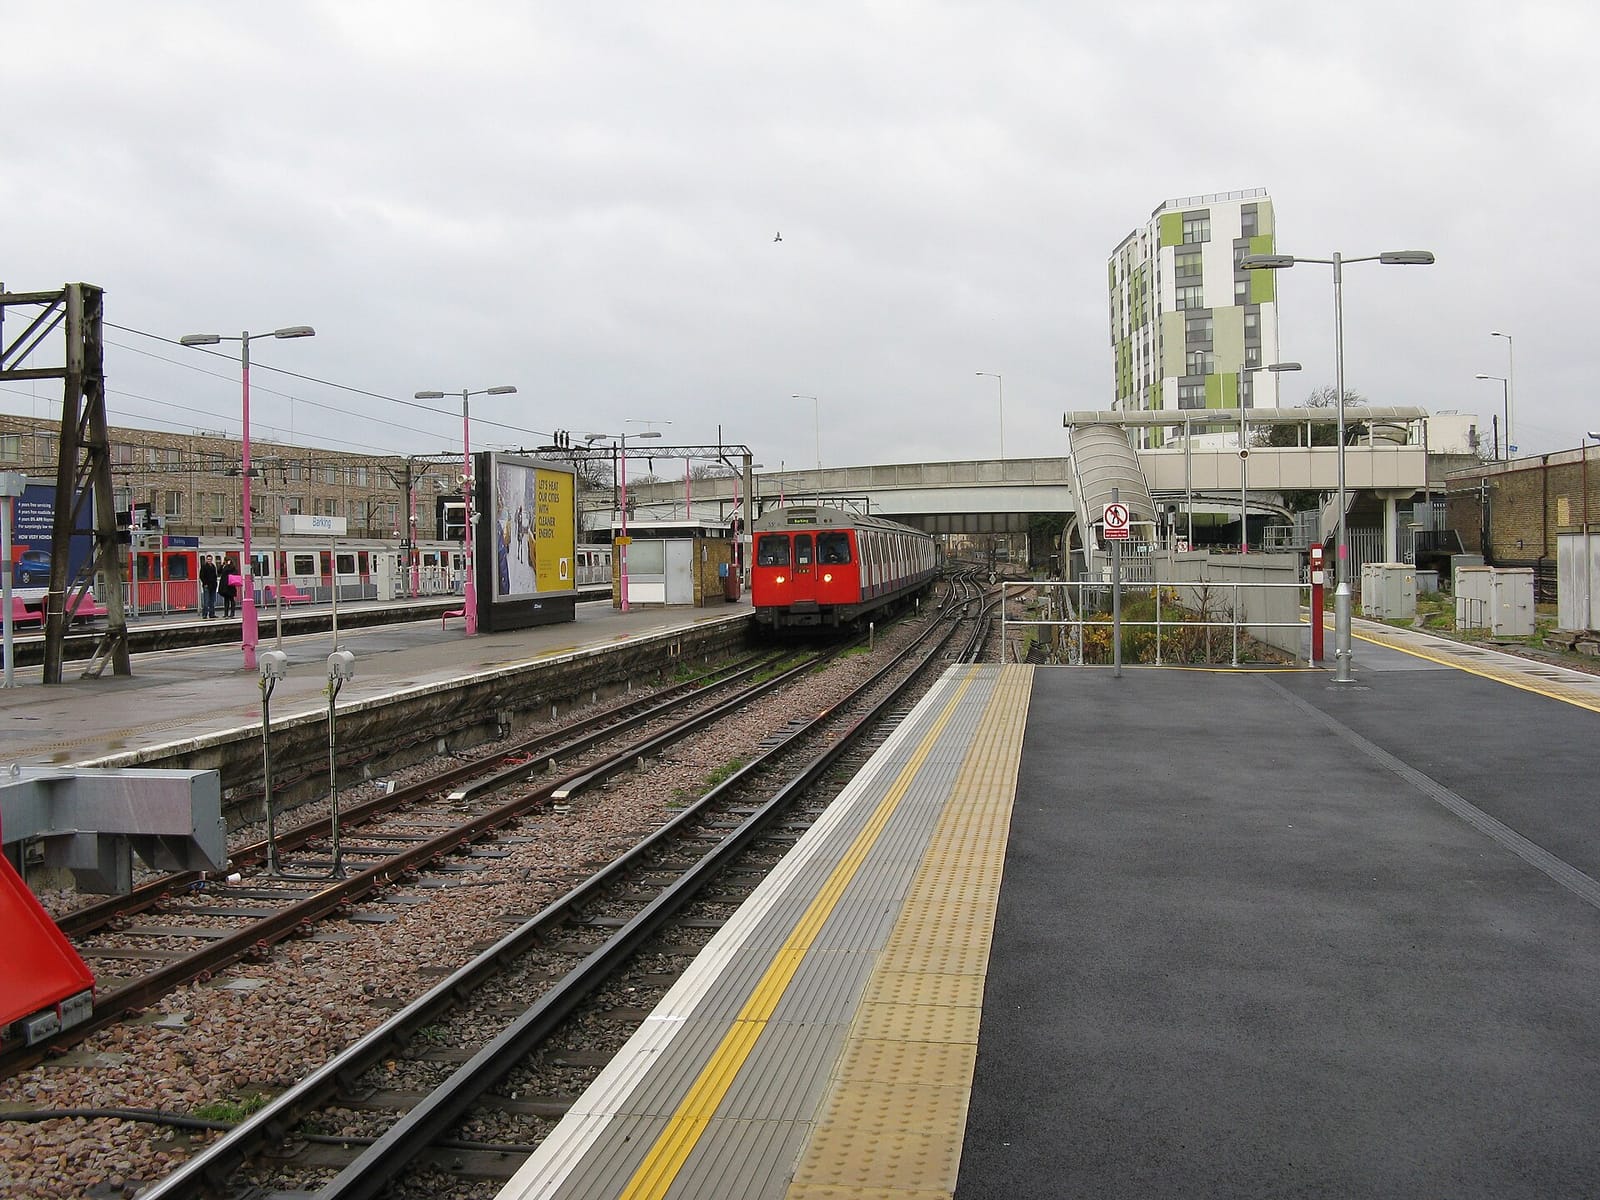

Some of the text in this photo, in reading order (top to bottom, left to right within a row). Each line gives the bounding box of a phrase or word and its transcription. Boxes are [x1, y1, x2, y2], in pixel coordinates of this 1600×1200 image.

[549, 480, 559, 491] HEAT
[539, 492, 559, 503] OUR CITIES
[539, 504, 549, 514] WITH
[312, 517, 331, 529] Barking
[539, 516, 555, 527] CLEANER
